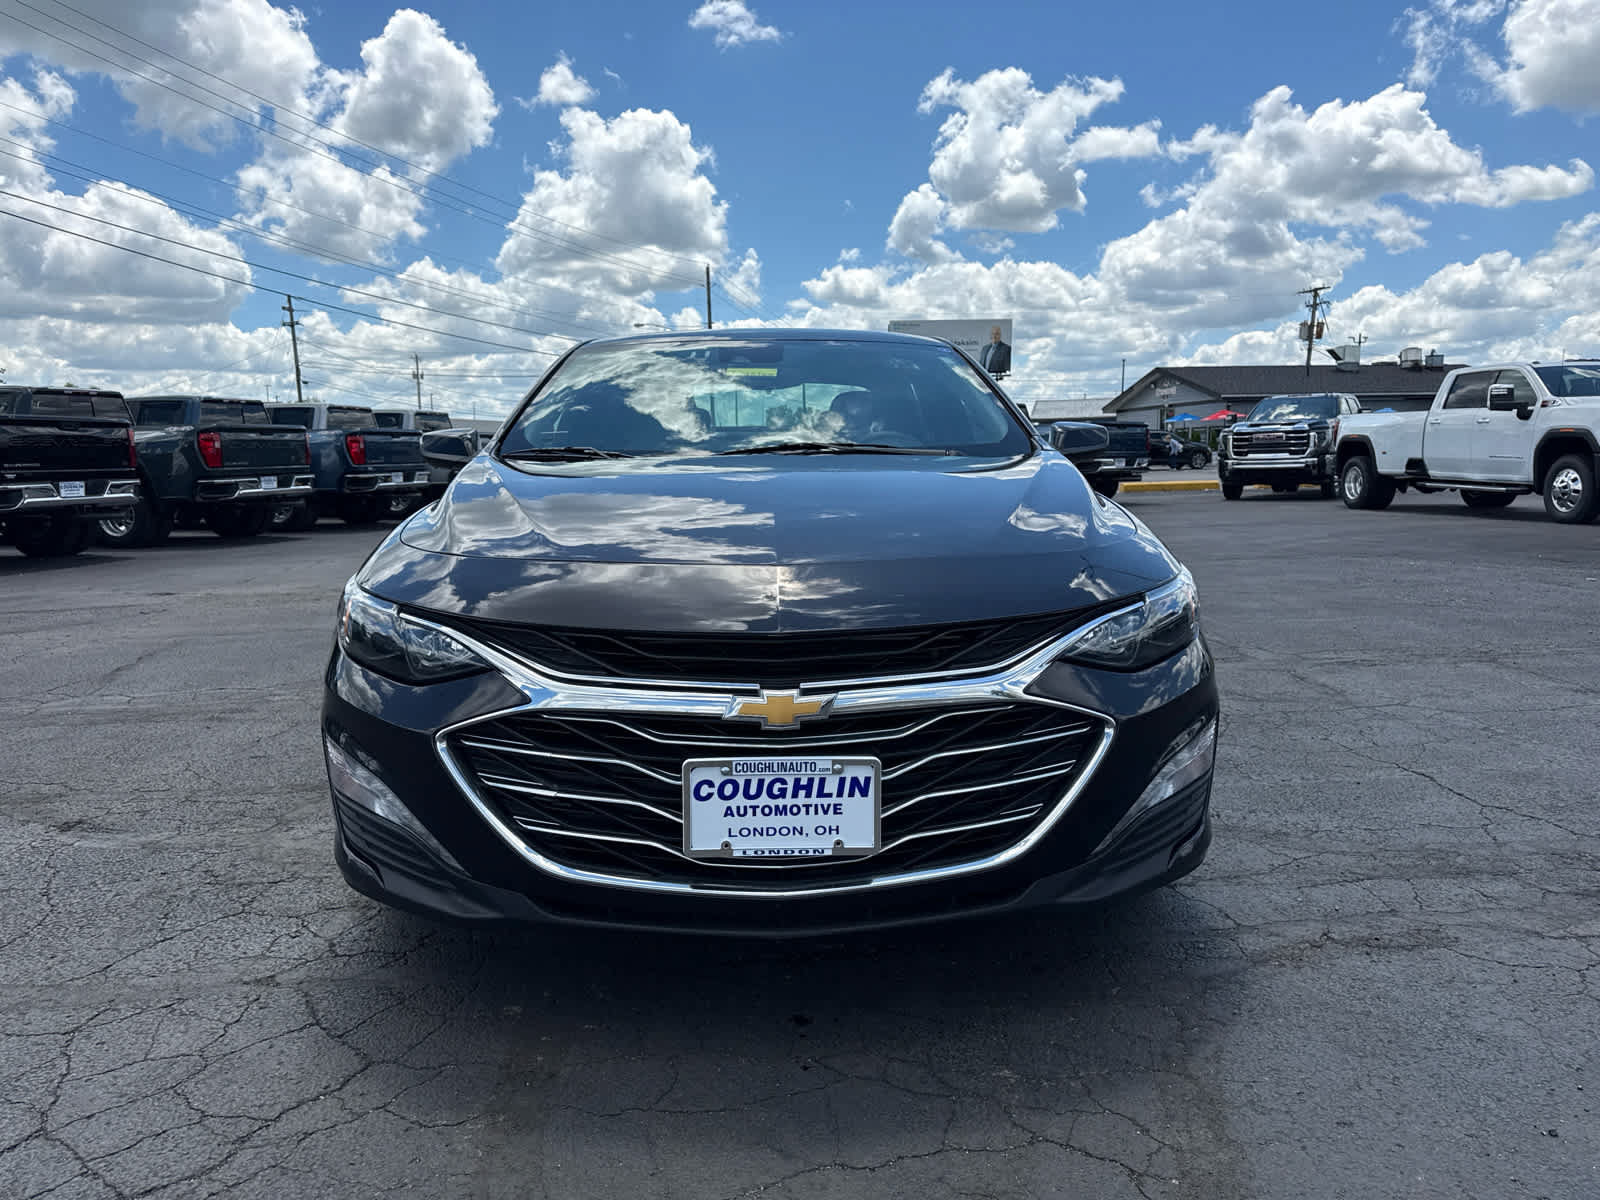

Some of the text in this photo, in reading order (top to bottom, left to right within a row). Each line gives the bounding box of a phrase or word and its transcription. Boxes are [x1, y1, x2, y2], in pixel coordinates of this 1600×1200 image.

[734, 761, 831, 774] COUGHLINAUTO.com
[693, 776, 872, 802] COUGHLIN
[723, 803, 843, 818] AUTOMOTIVE
[727, 825, 840, 838] LONDON, OH
